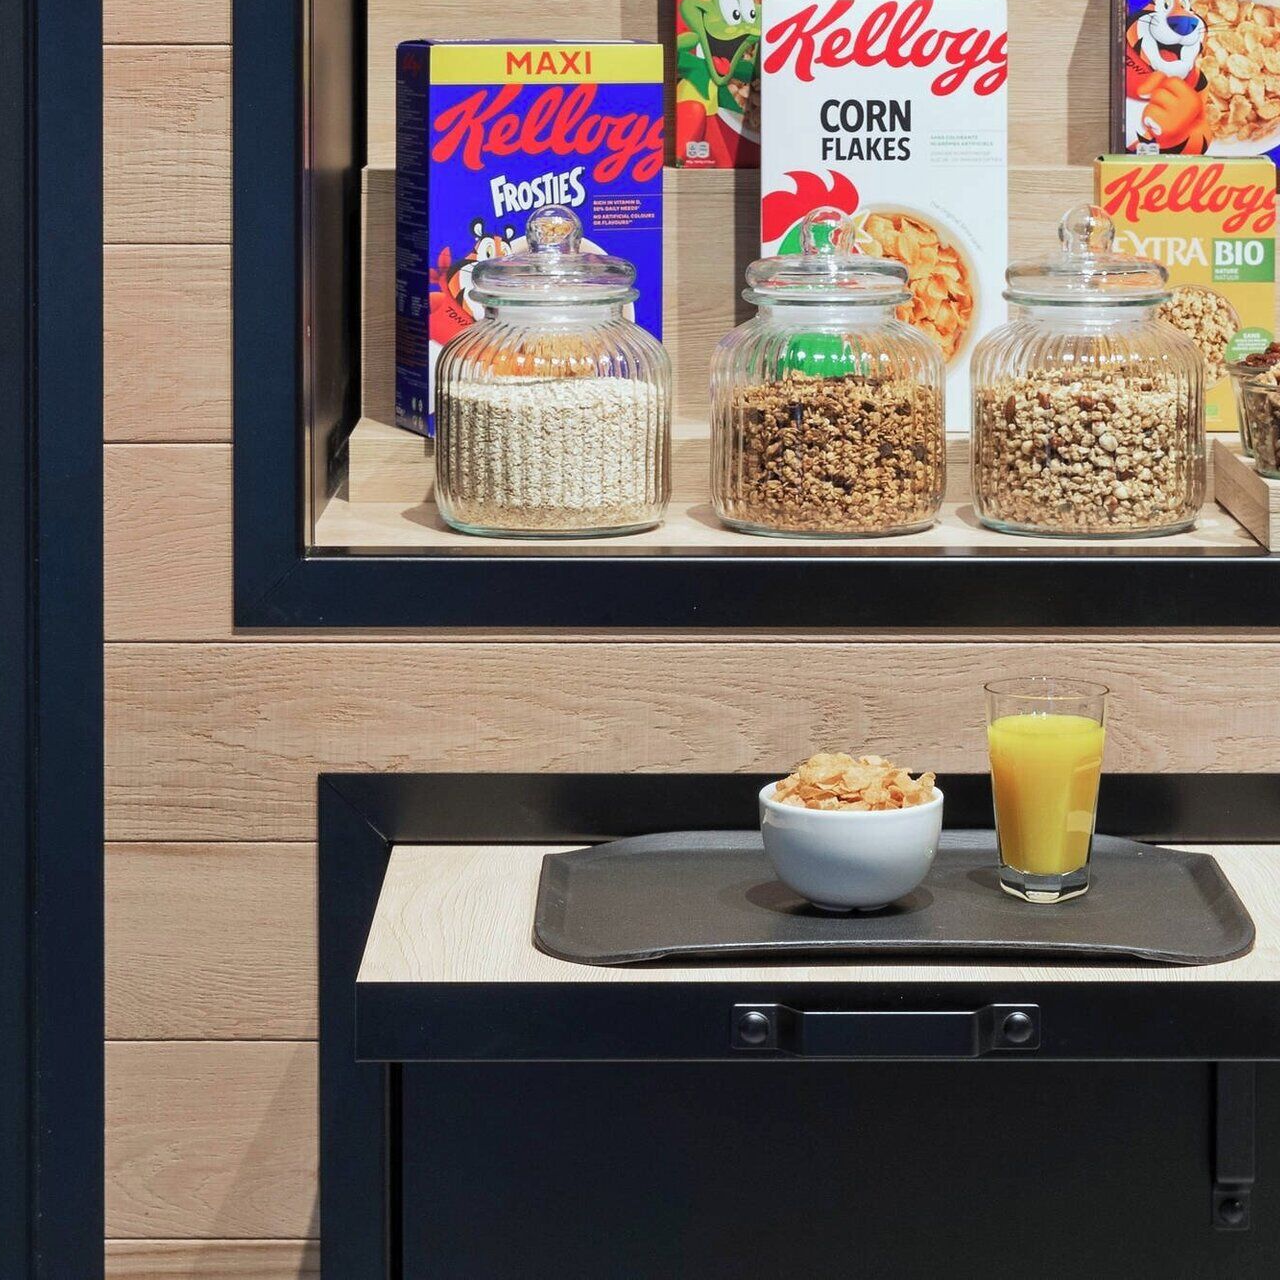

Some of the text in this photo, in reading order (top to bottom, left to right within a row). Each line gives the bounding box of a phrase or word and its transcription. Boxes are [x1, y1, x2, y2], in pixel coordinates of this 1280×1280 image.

[506, 51, 592, 75] MAXI
[820, 99, 912, 133] CORN
[821, 137, 911, 162] FLAKES
[489, 166, 585, 218] FROSTIES
[1214, 240, 1265, 266] BIO
[445, 306, 472, 326] TONY
